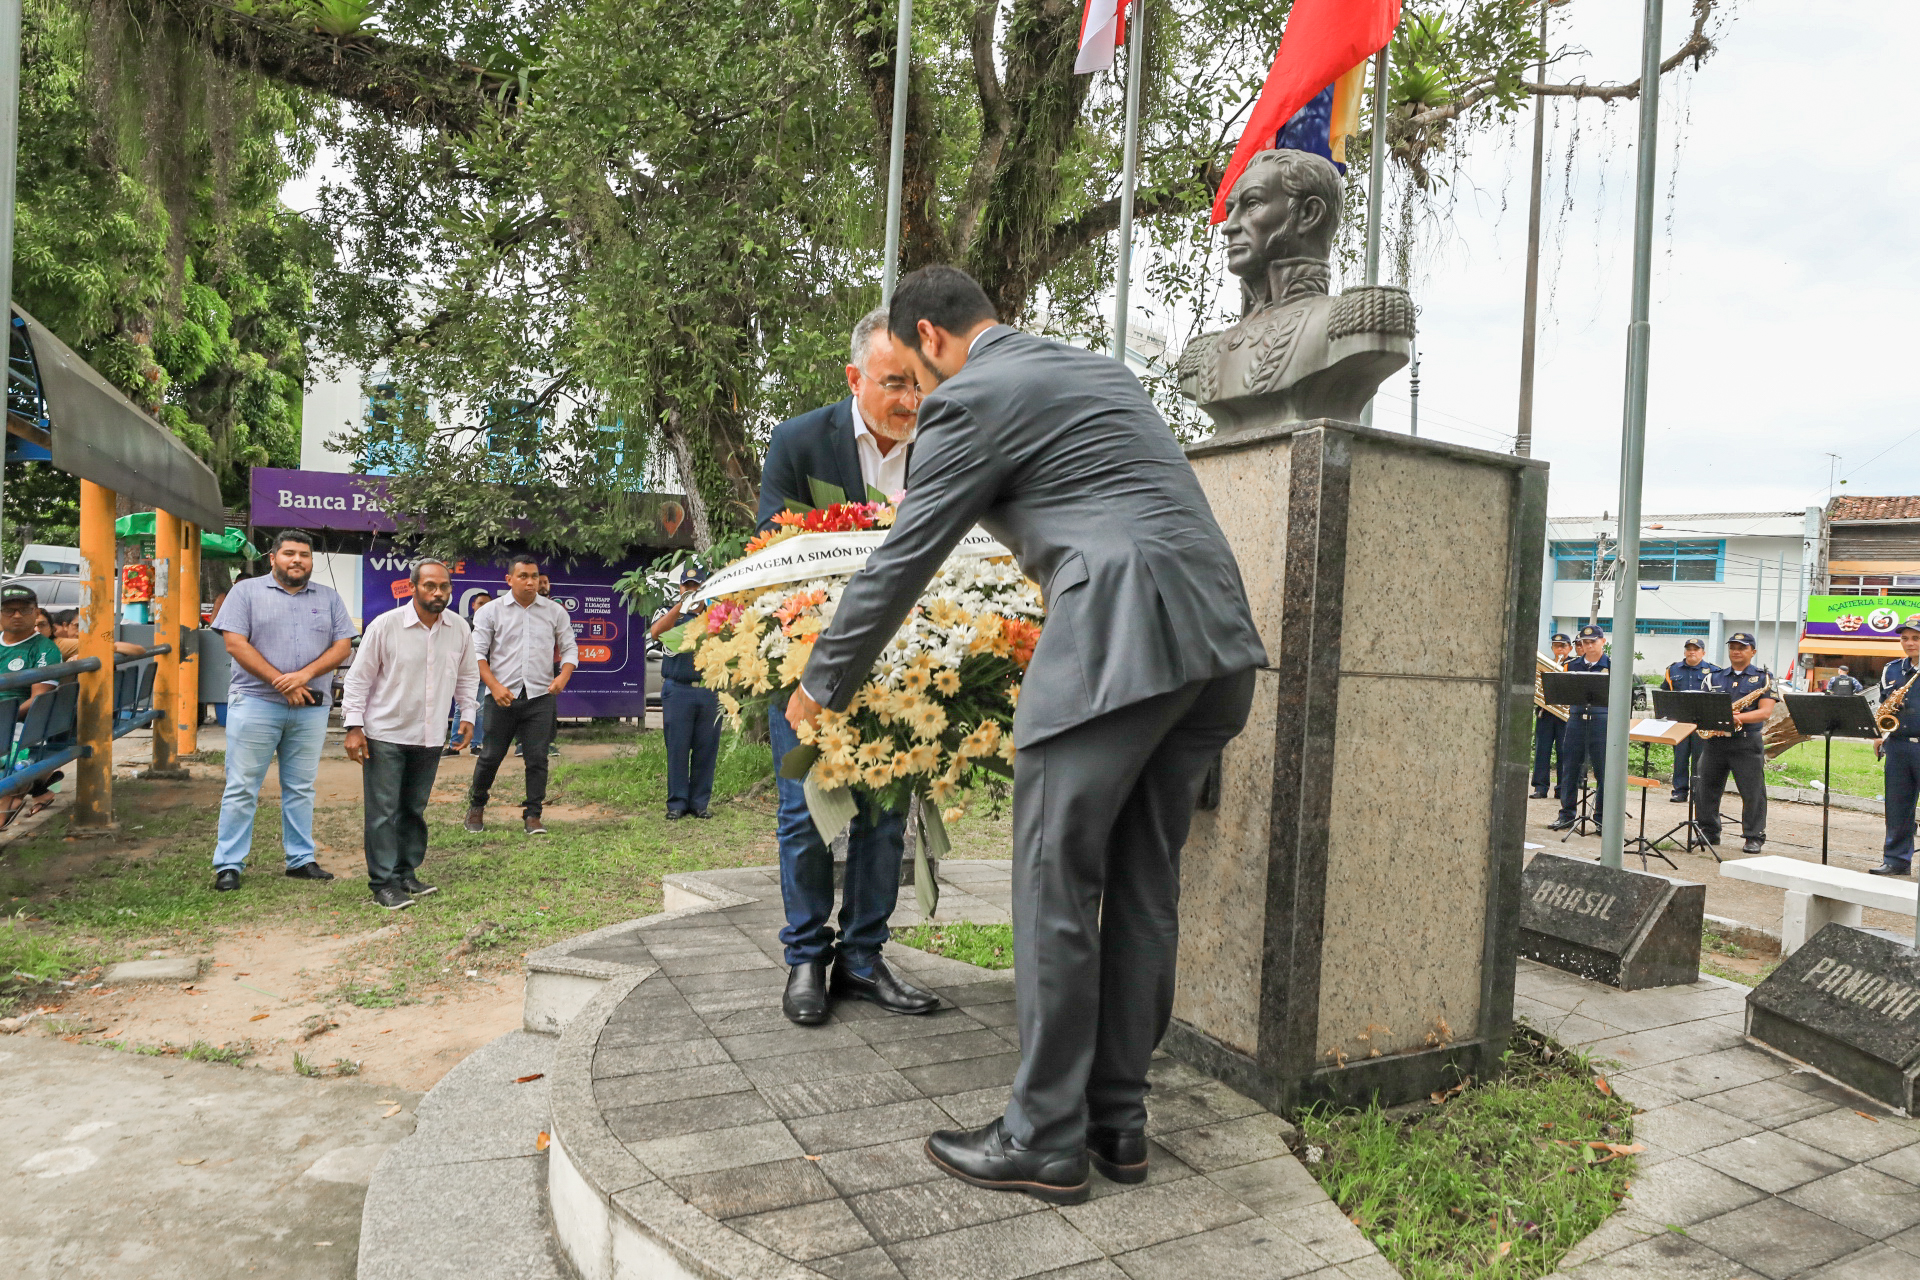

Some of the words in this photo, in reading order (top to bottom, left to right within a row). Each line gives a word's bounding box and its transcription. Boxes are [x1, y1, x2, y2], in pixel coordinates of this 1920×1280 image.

[278, 489, 346, 511] Banca
[796, 554, 805, 564] A
[808, 547, 852, 562] SIMÓN
[1828, 599, 1874, 612] AÇAITERIA
[1532, 879, 1616, 921] BRASIL
